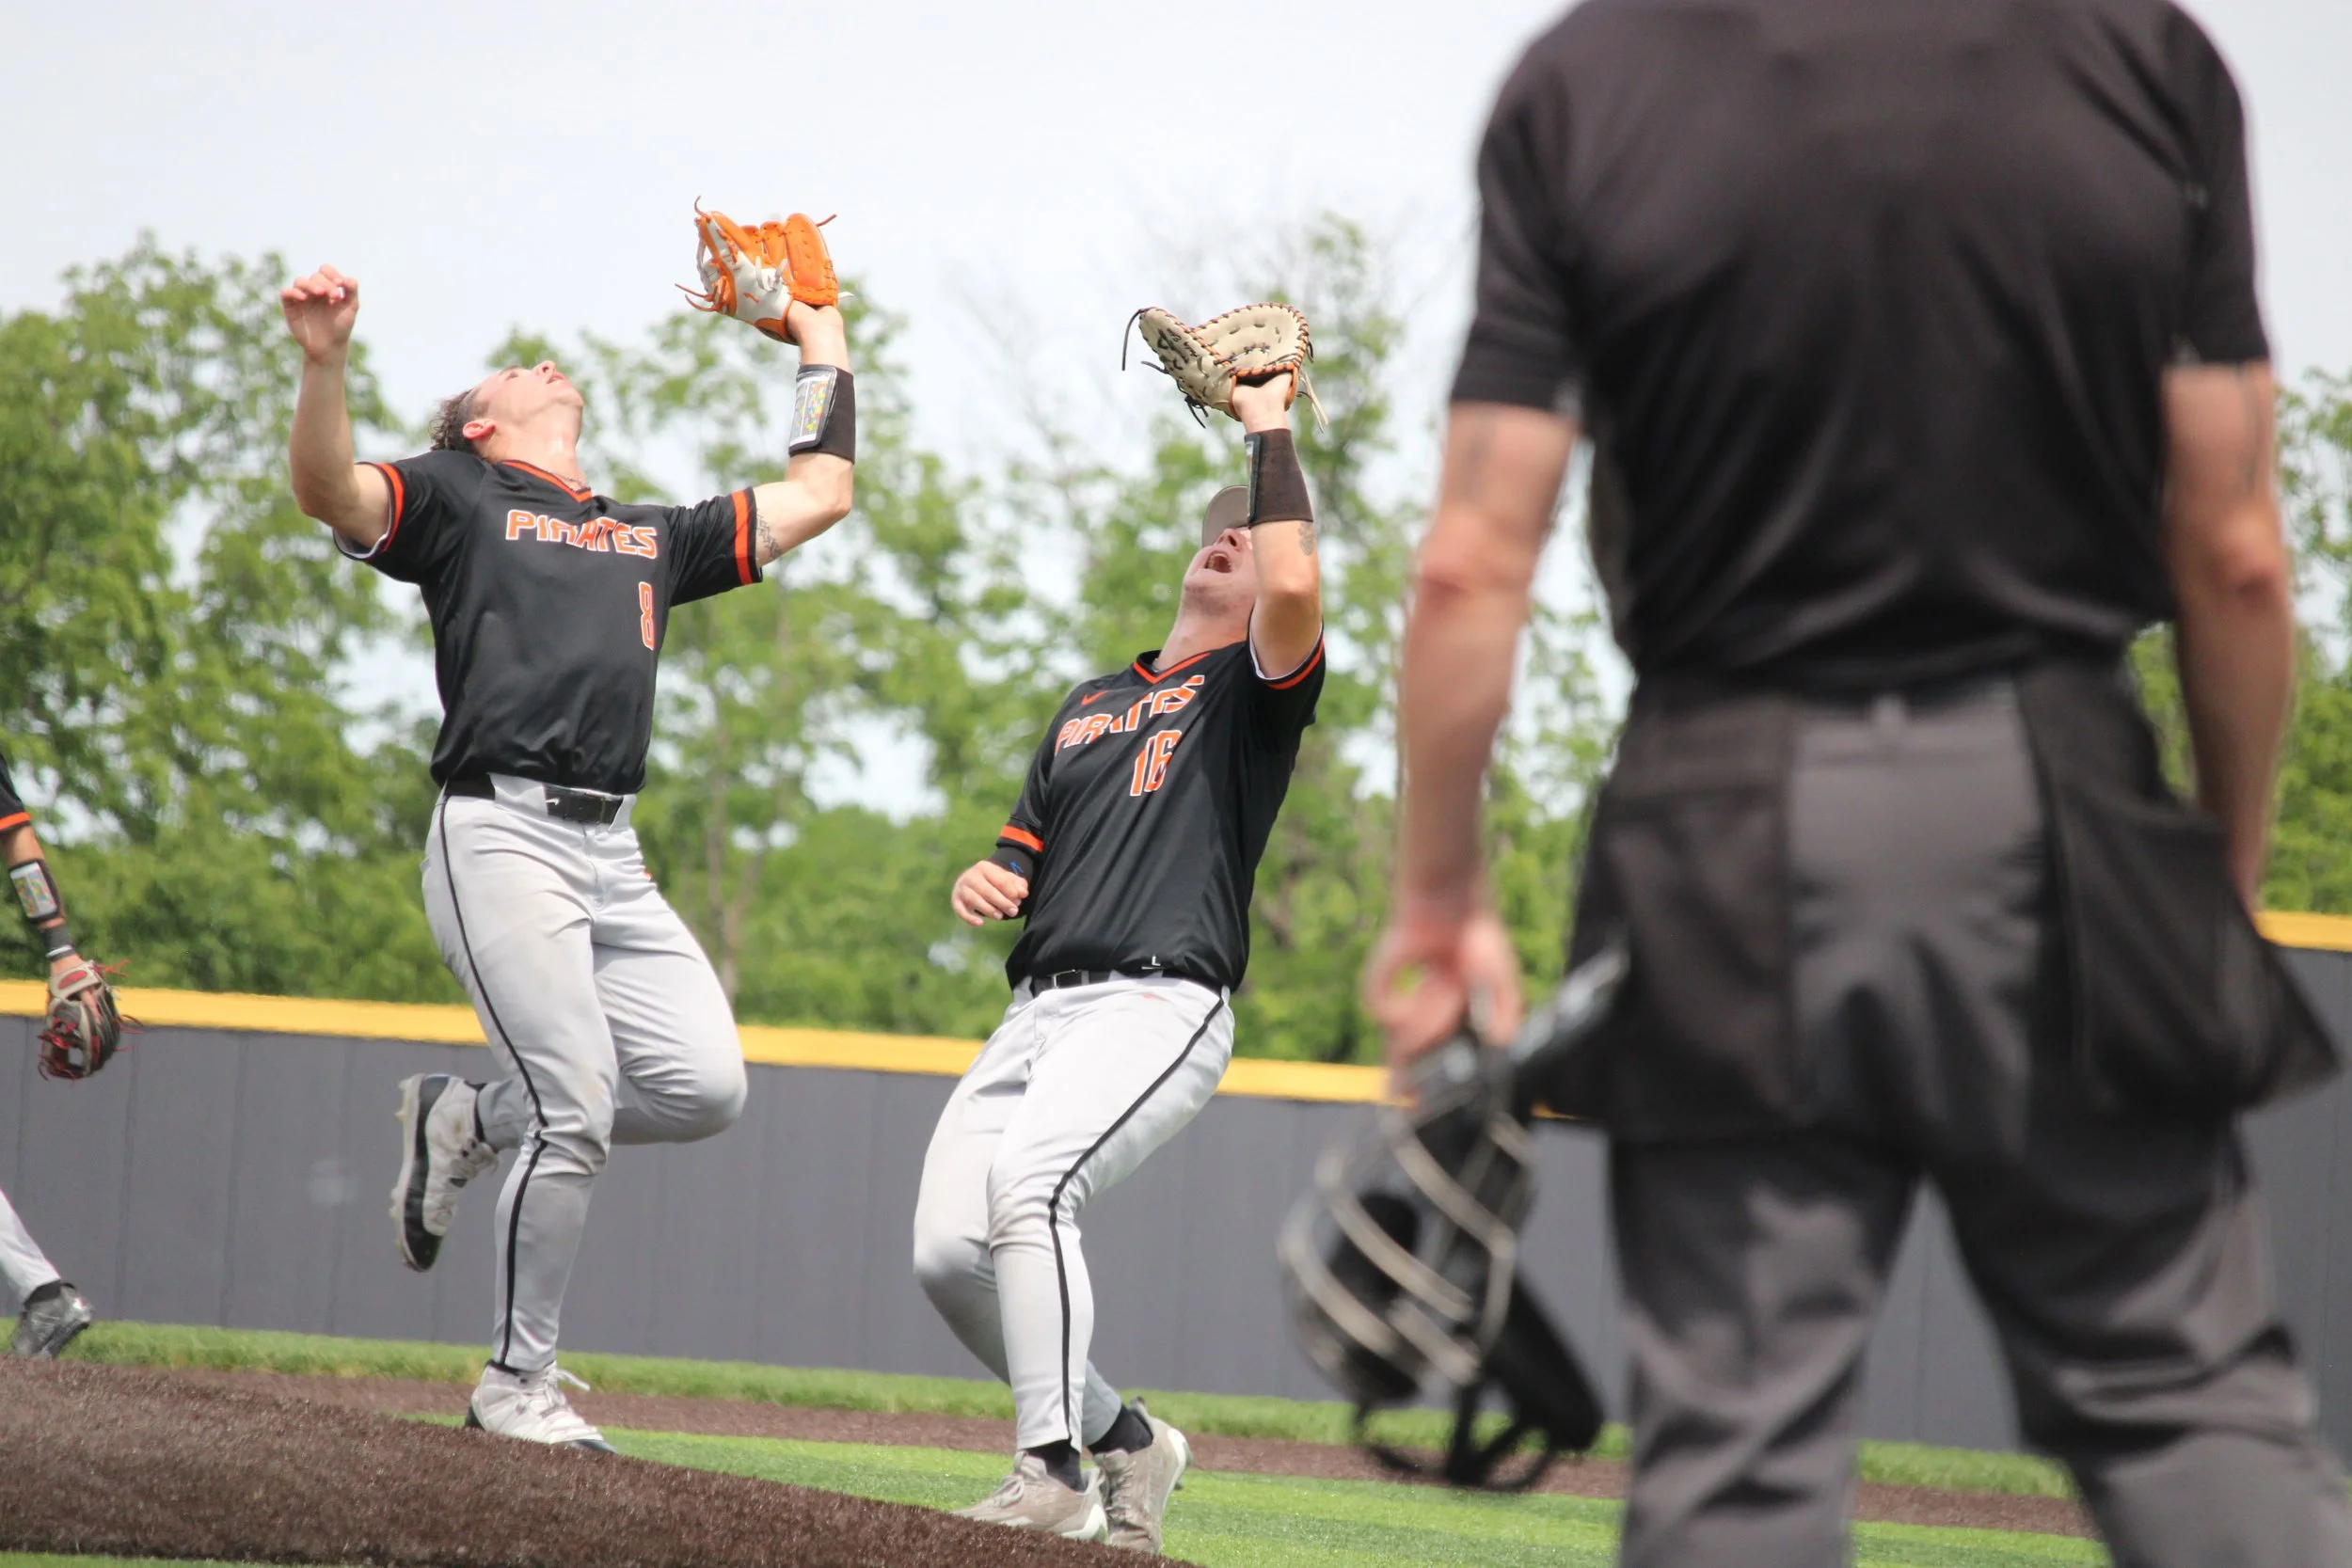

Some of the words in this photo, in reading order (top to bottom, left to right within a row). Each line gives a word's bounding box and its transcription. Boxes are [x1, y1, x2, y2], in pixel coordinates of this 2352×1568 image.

[505, 509, 658, 560] PIRATES
[638, 580, 655, 651] 8
[1129, 729, 1183, 797] 16
